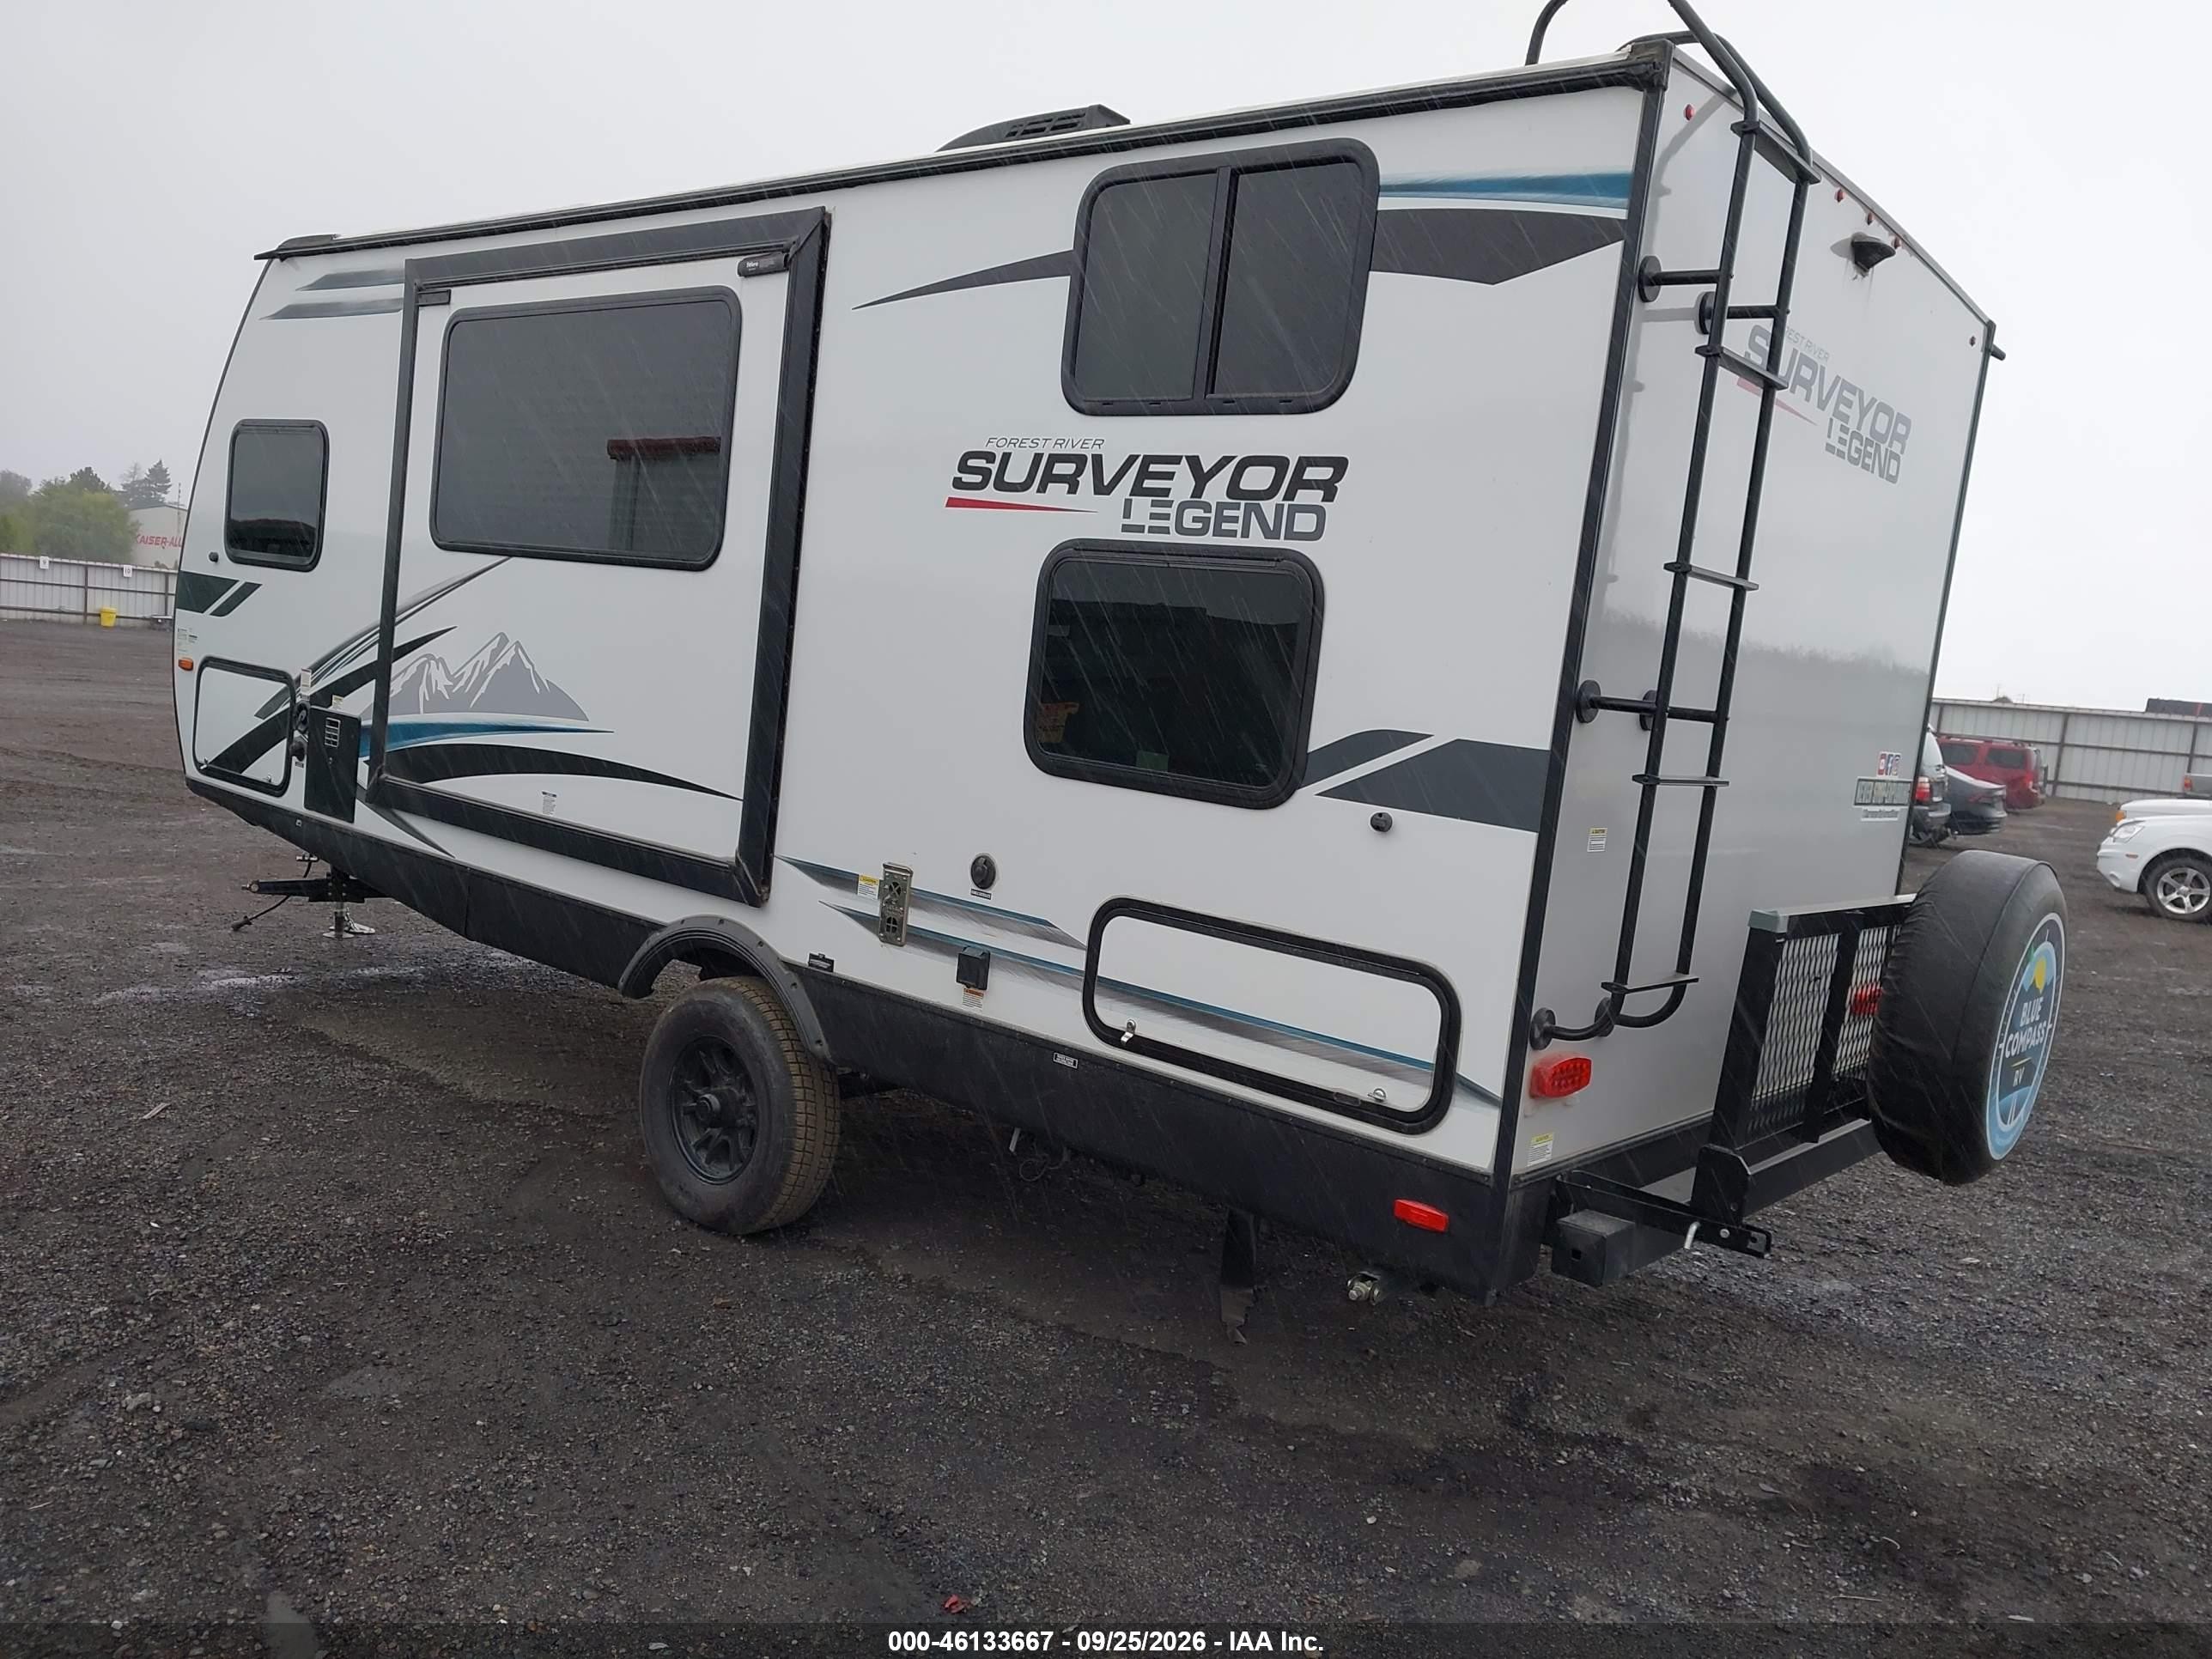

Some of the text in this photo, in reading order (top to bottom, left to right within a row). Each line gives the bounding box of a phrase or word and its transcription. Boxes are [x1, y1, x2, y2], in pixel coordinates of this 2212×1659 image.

[1805, 339, 1829, 361] RIVER
[986, 437, 1105, 451] FOREST RIVER
[1825, 417, 1901, 484] LEGEND
[951, 451, 1349, 503] SURVEYOR
[1121, 498, 1327, 542] LEGEND
[2020, 996, 2044, 1027] BLUE
[2006, 1021, 2046, 1058] COMPASS
[2014, 1067, 2025, 1086] RV
